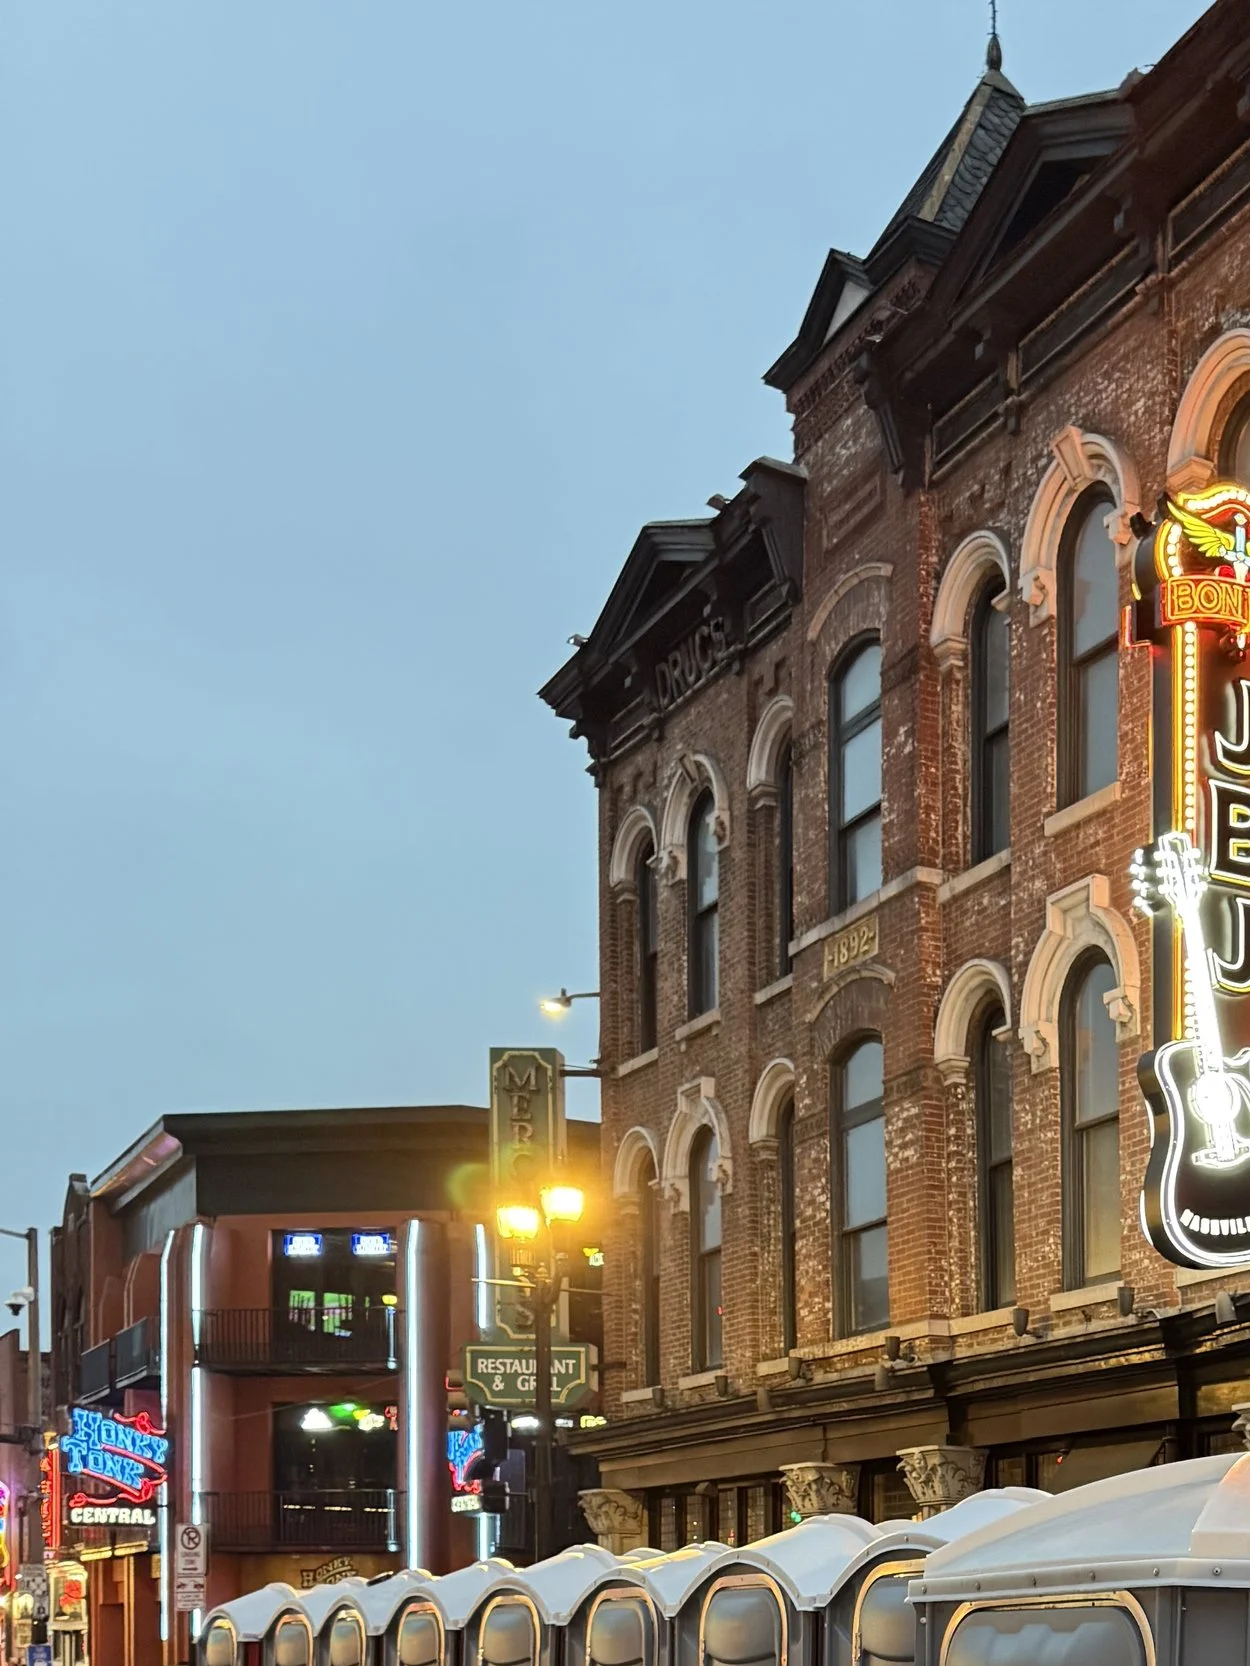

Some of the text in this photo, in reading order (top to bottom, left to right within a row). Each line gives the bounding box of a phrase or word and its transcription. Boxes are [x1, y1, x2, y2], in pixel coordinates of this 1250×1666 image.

[1172, 579, 1244, 620] BON
[477, 1358, 576, 1374] RESTAUNT
[492, 1375, 562, 1391] & GRL
[71, 1407, 168, 1464] HONKY
[61, 1436, 145, 1490] TONK
[70, 1507, 156, 1525] CENTRAL
